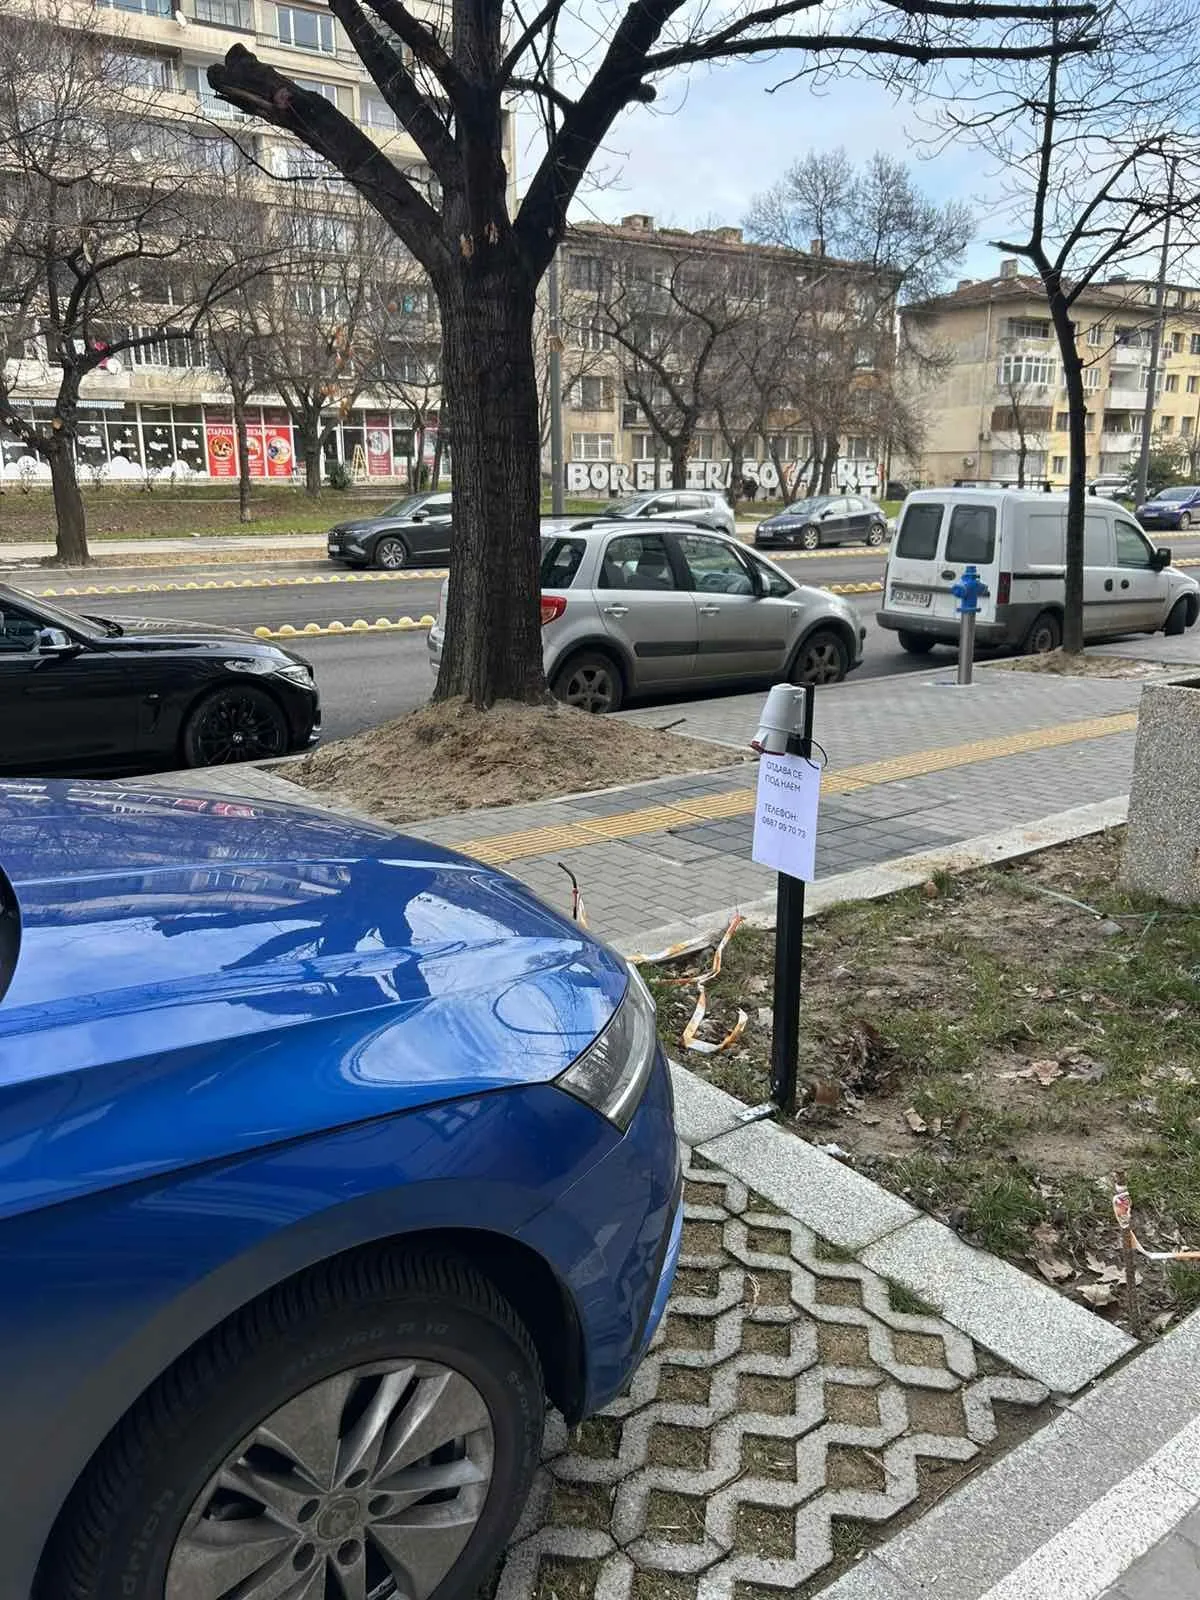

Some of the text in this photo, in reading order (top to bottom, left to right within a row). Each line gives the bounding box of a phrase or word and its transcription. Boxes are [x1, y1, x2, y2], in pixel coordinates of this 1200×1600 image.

[767, 761, 803, 779] ОТДАВА СЕ
[765, 774, 801, 792] ПОД НАЕМ
[764, 803, 798, 821] ТЕЛЕФОН:
